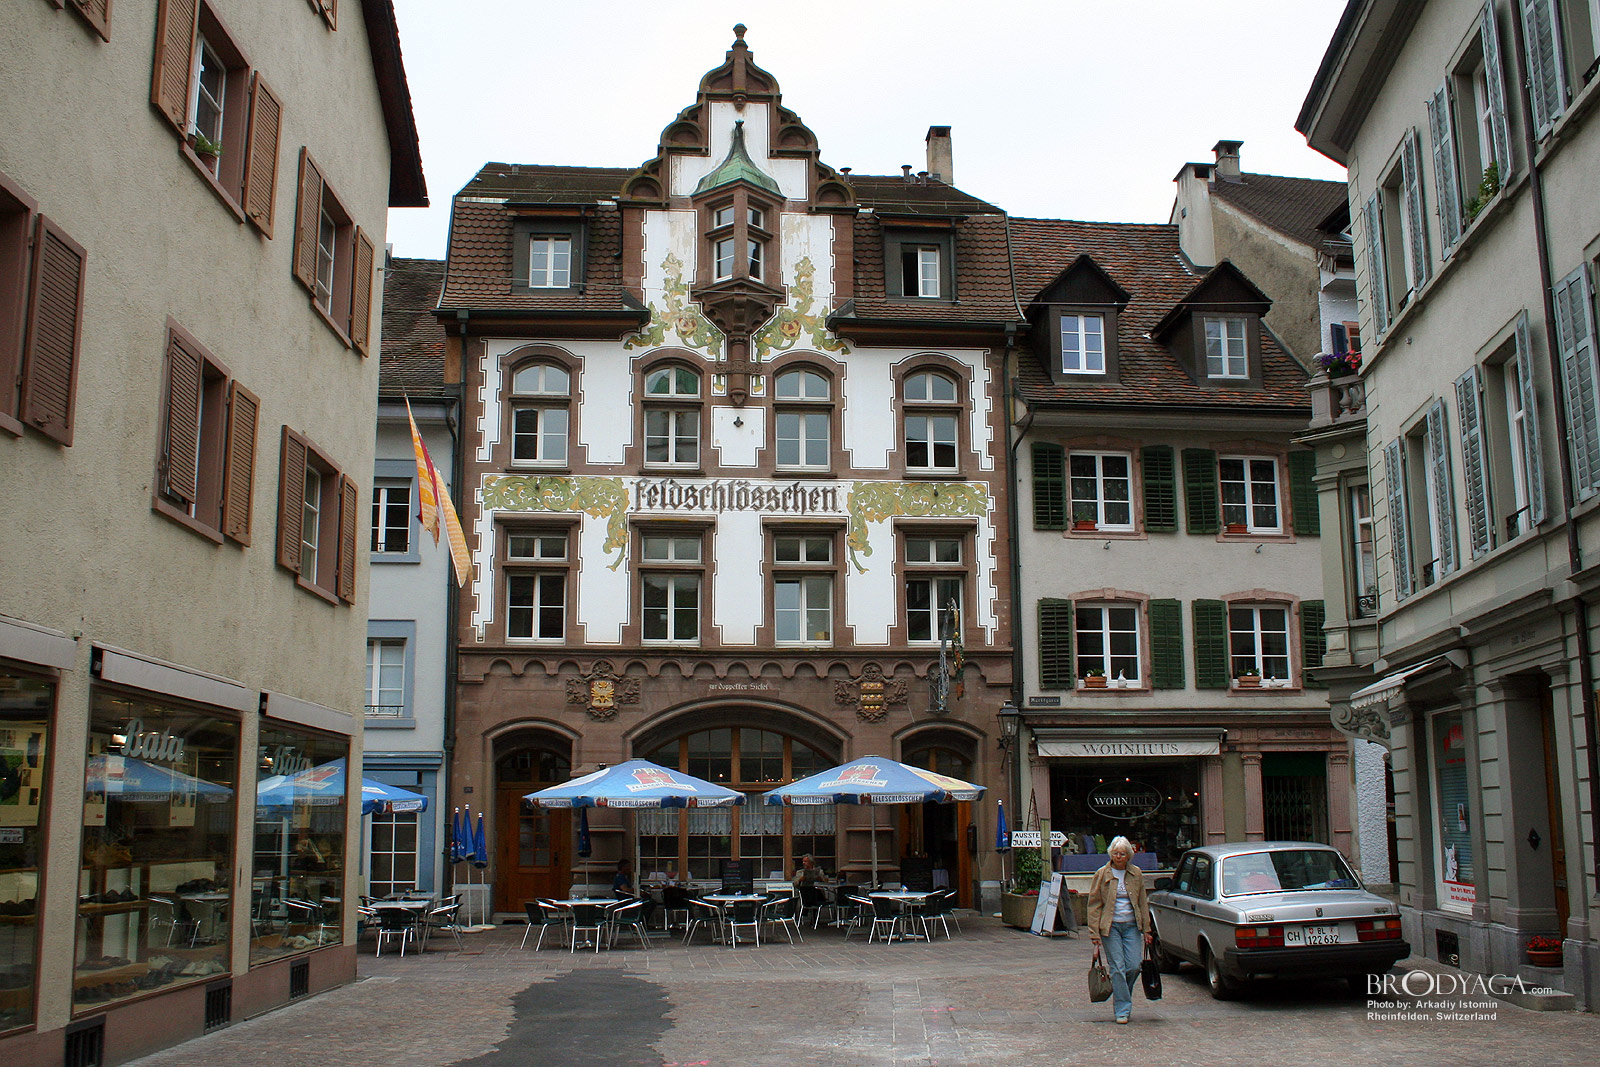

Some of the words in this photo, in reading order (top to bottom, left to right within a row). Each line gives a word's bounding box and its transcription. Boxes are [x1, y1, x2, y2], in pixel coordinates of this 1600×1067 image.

[121, 717, 185, 762] Bata
[1082, 743, 1179, 755] WOHNHUUS
[1095, 797, 1157, 806] WOHNHUUS
[1287, 931, 1300, 942] CH
[1307, 935, 1322, 945] 122
[1324, 934, 1339, 944] 632
